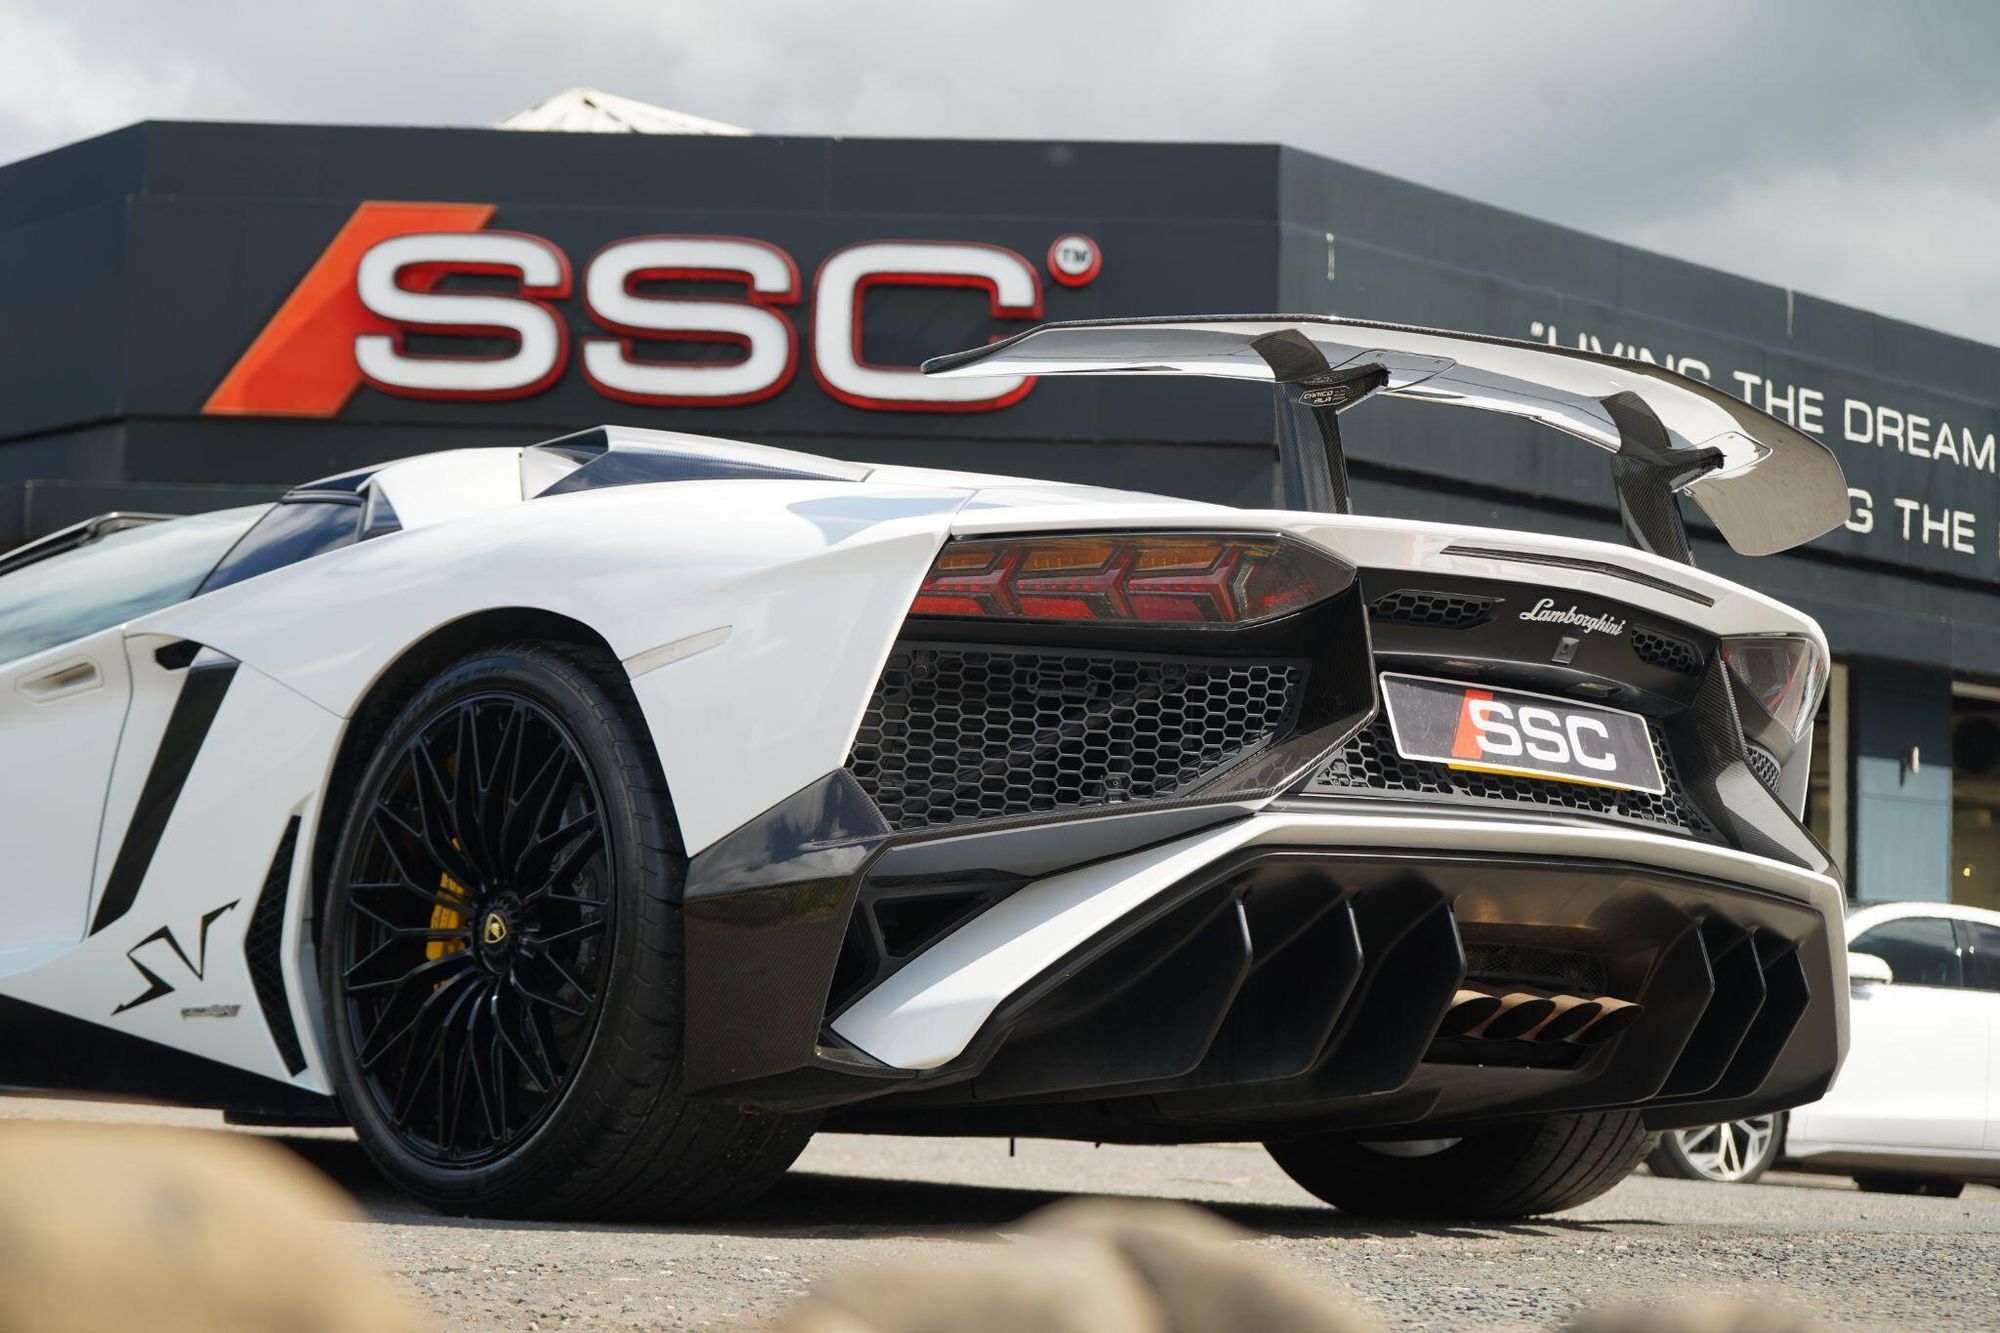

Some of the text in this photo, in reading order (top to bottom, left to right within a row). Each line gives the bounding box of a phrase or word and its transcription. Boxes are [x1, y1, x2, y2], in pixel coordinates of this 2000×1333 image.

[355, 231, 1043, 411] SSC
[1733, 370, 1996, 473] THE DREAM
[1894, 497, 1976, 555] THE
[1519, 598, 1627, 636] Lamborghini
[1468, 699, 1617, 771] SSC
